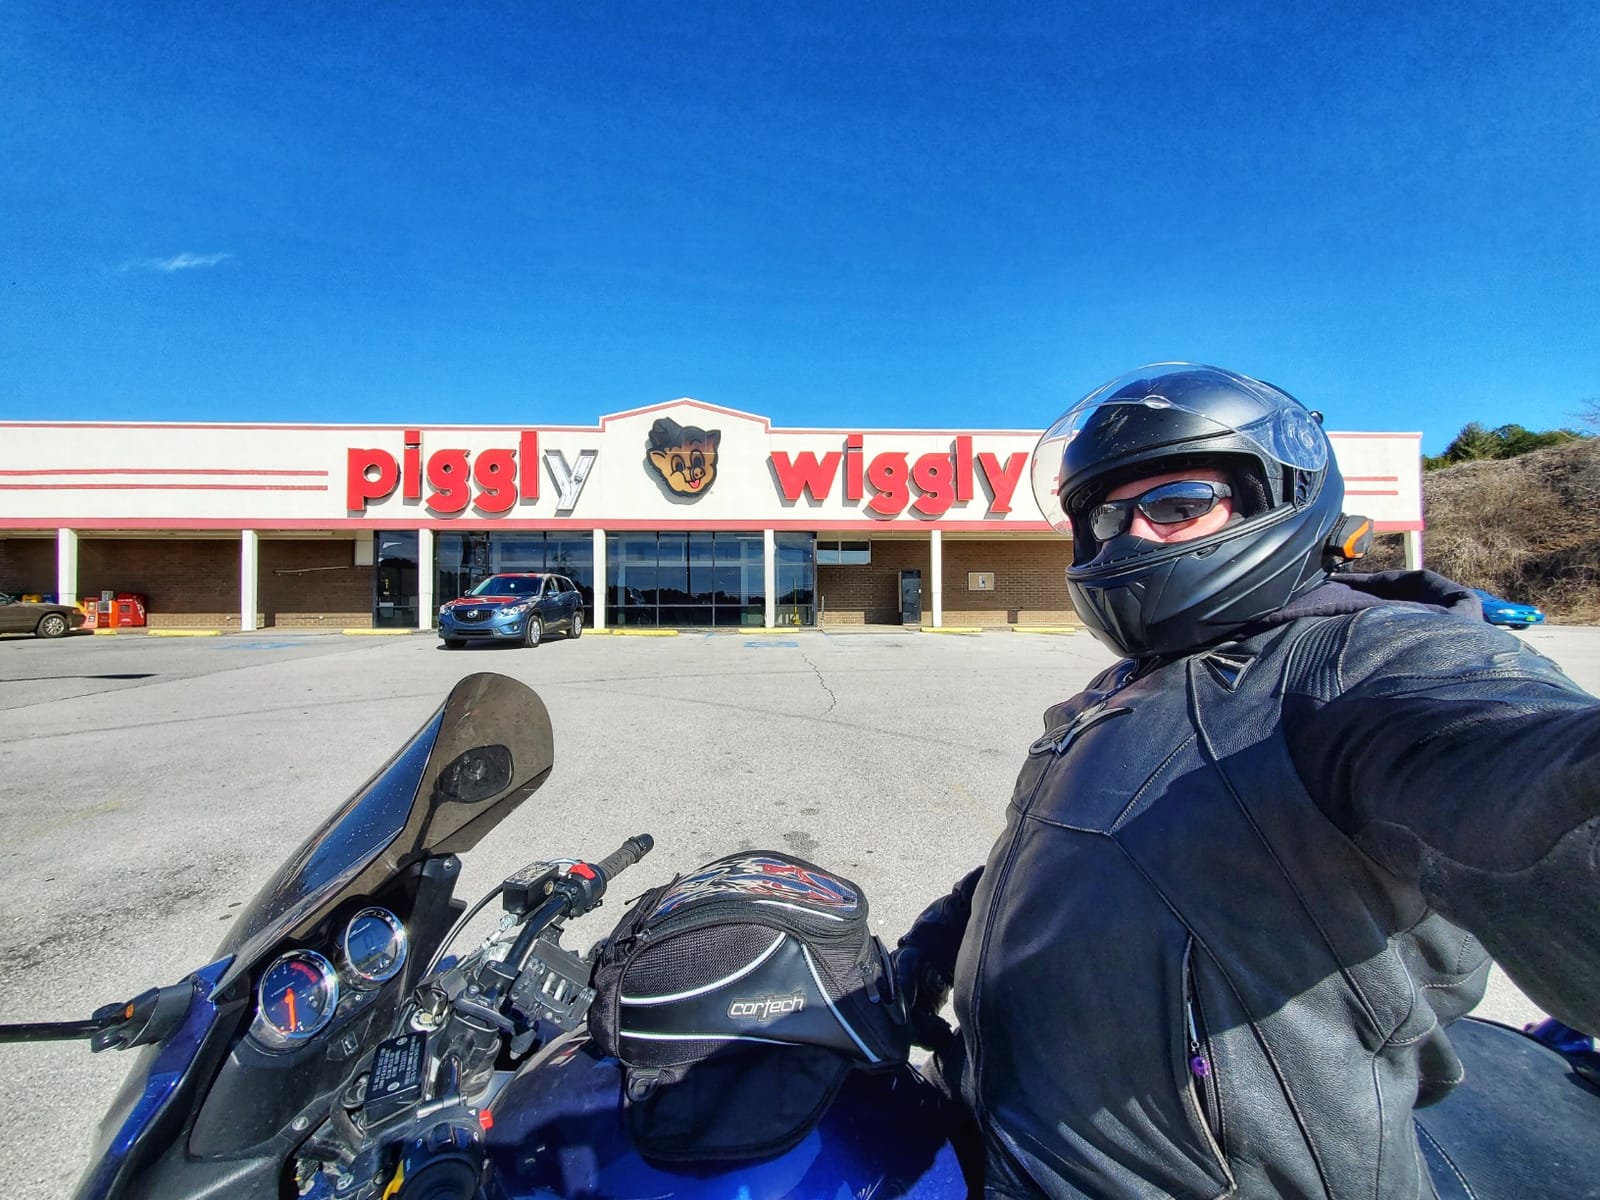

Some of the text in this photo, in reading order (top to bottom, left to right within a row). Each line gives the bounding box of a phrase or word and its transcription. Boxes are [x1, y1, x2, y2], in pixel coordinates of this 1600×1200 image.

[347, 431, 1029, 514] piggly wiggly
[729, 995, 805, 1019] cortech
